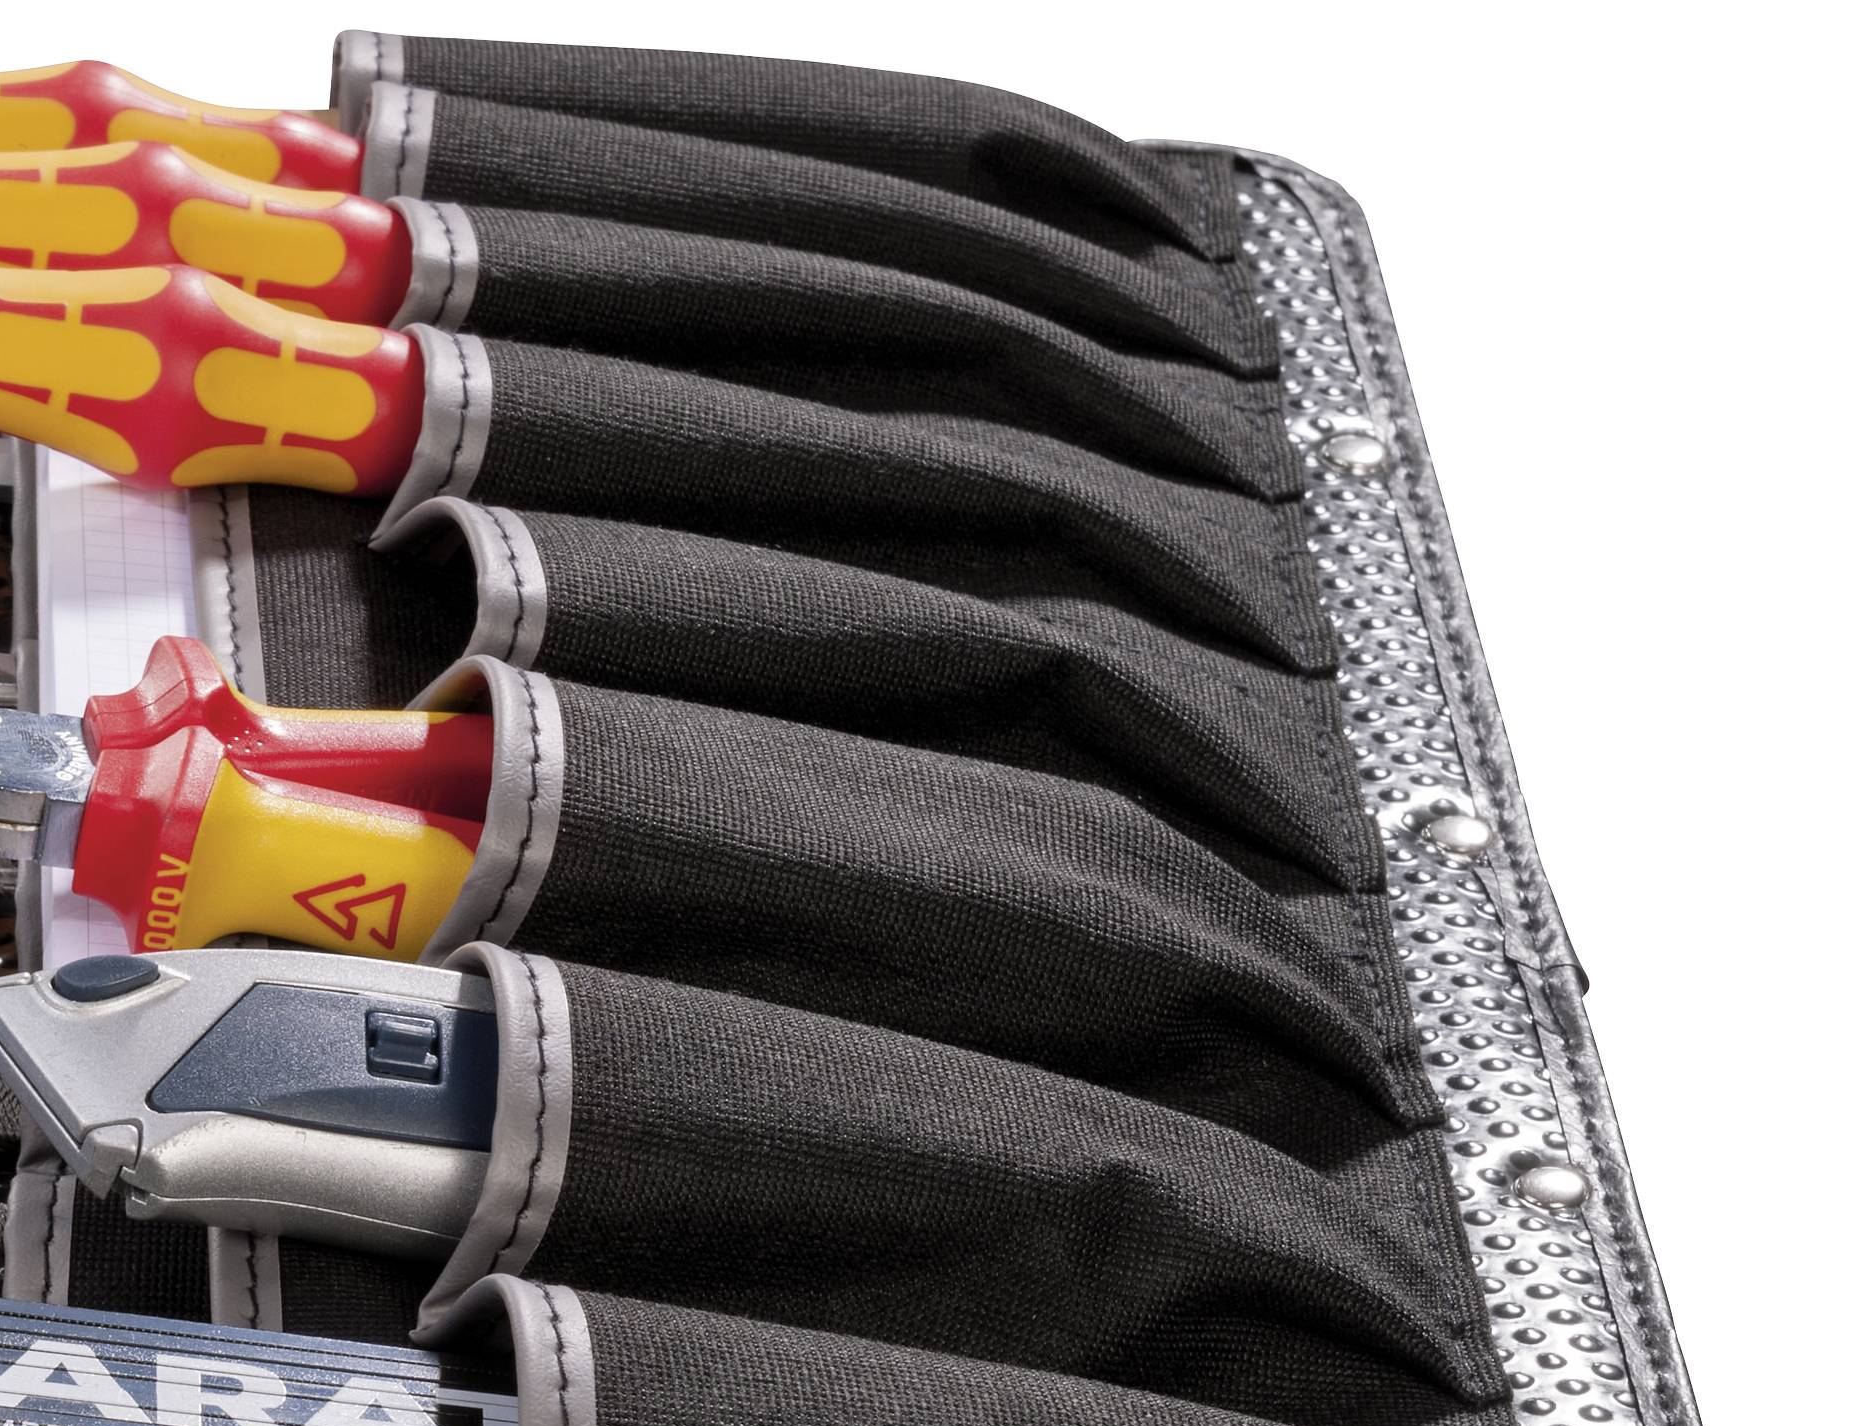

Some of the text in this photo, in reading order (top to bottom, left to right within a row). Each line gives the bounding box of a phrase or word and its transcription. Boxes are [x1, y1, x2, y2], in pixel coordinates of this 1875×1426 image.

[54, 731, 90, 781] GERMANY
[142, 853, 190, 951] 000 V
